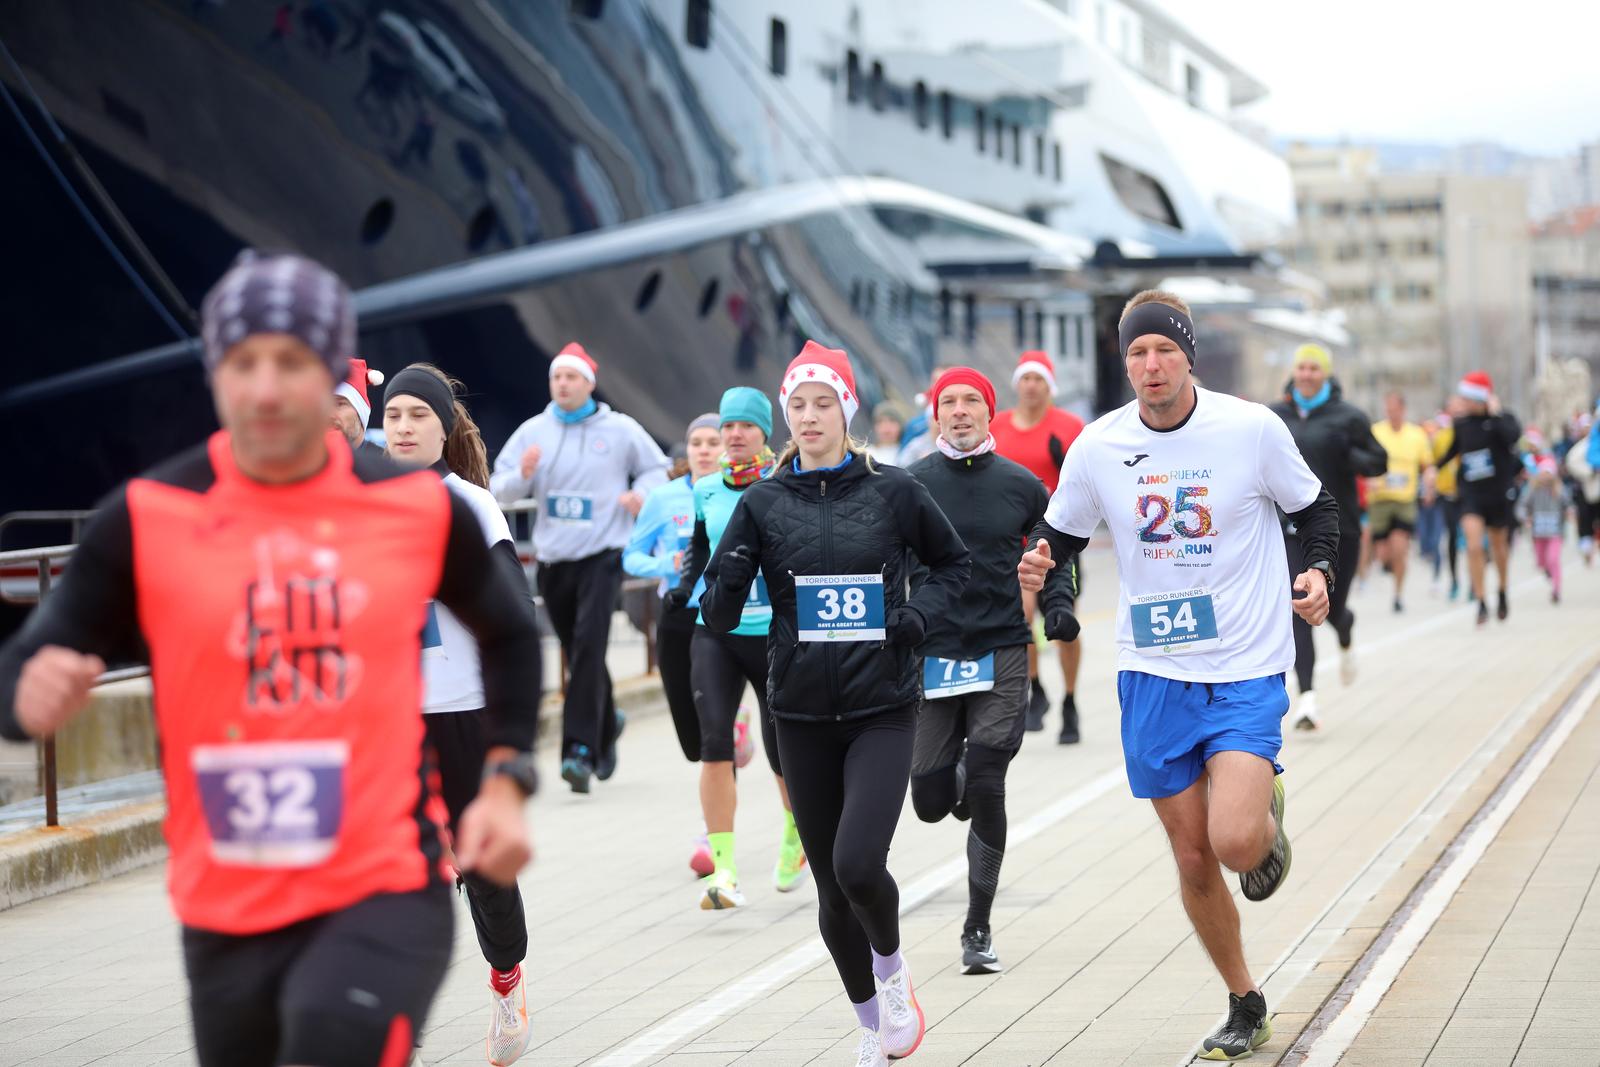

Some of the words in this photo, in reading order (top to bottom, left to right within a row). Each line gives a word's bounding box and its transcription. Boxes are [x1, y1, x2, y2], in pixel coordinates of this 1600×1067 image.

[1137, 475, 1168, 485] AJMO
[1170, 469, 1212, 480] RIJEKA!
[555, 496, 584, 517] 69
[1137, 486, 1212, 543] 25
[1143, 548, 1185, 560] RIJEKA
[1185, 544, 1212, 555] RUN
[817, 587, 866, 620] 38
[1138, 594, 1168, 602] TORPEDO
[1170, 589, 1203, 599] RUNNERS
[1150, 601, 1197, 636] 54
[938, 657, 979, 681] 75
[224, 769, 319, 831] 32
